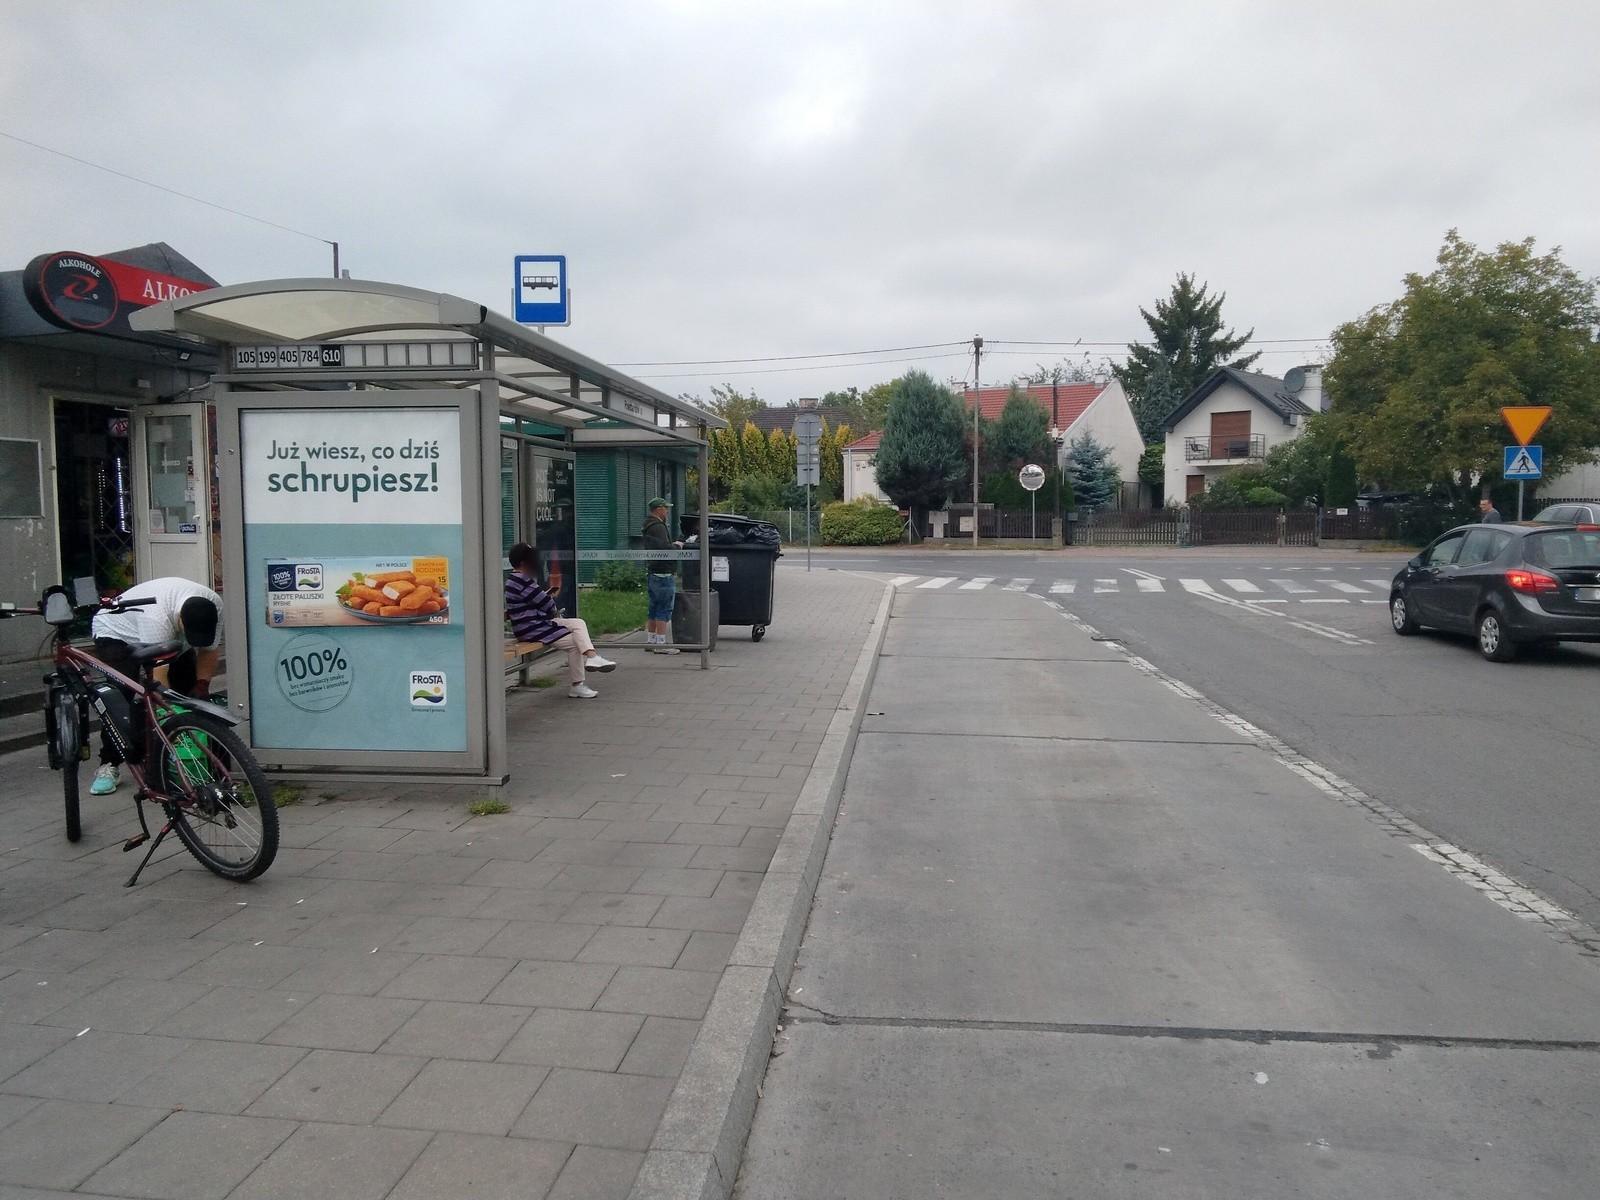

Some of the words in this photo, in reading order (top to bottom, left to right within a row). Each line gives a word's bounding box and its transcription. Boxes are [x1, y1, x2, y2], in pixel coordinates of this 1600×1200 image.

[58, 258, 101, 278] ALKOHOLE
[142, 278, 201, 301] ALKO
[238, 351, 255, 363] 105
[259, 351, 276, 363] 199
[280, 350, 298, 363] 405
[301, 350, 319, 362] 784
[322, 349, 340, 362] 610
[266, 439, 300, 460] Już
[305, 441, 366, 463] wiesz,
[371, 446, 395, 460] co
[399, 438, 440, 460] dziś
[267, 461, 439, 503] schrupiesz!
[273, 571, 291, 580] 100%
[280, 647, 347, 681] 100%
[412, 674, 444, 684] FRoSTA
